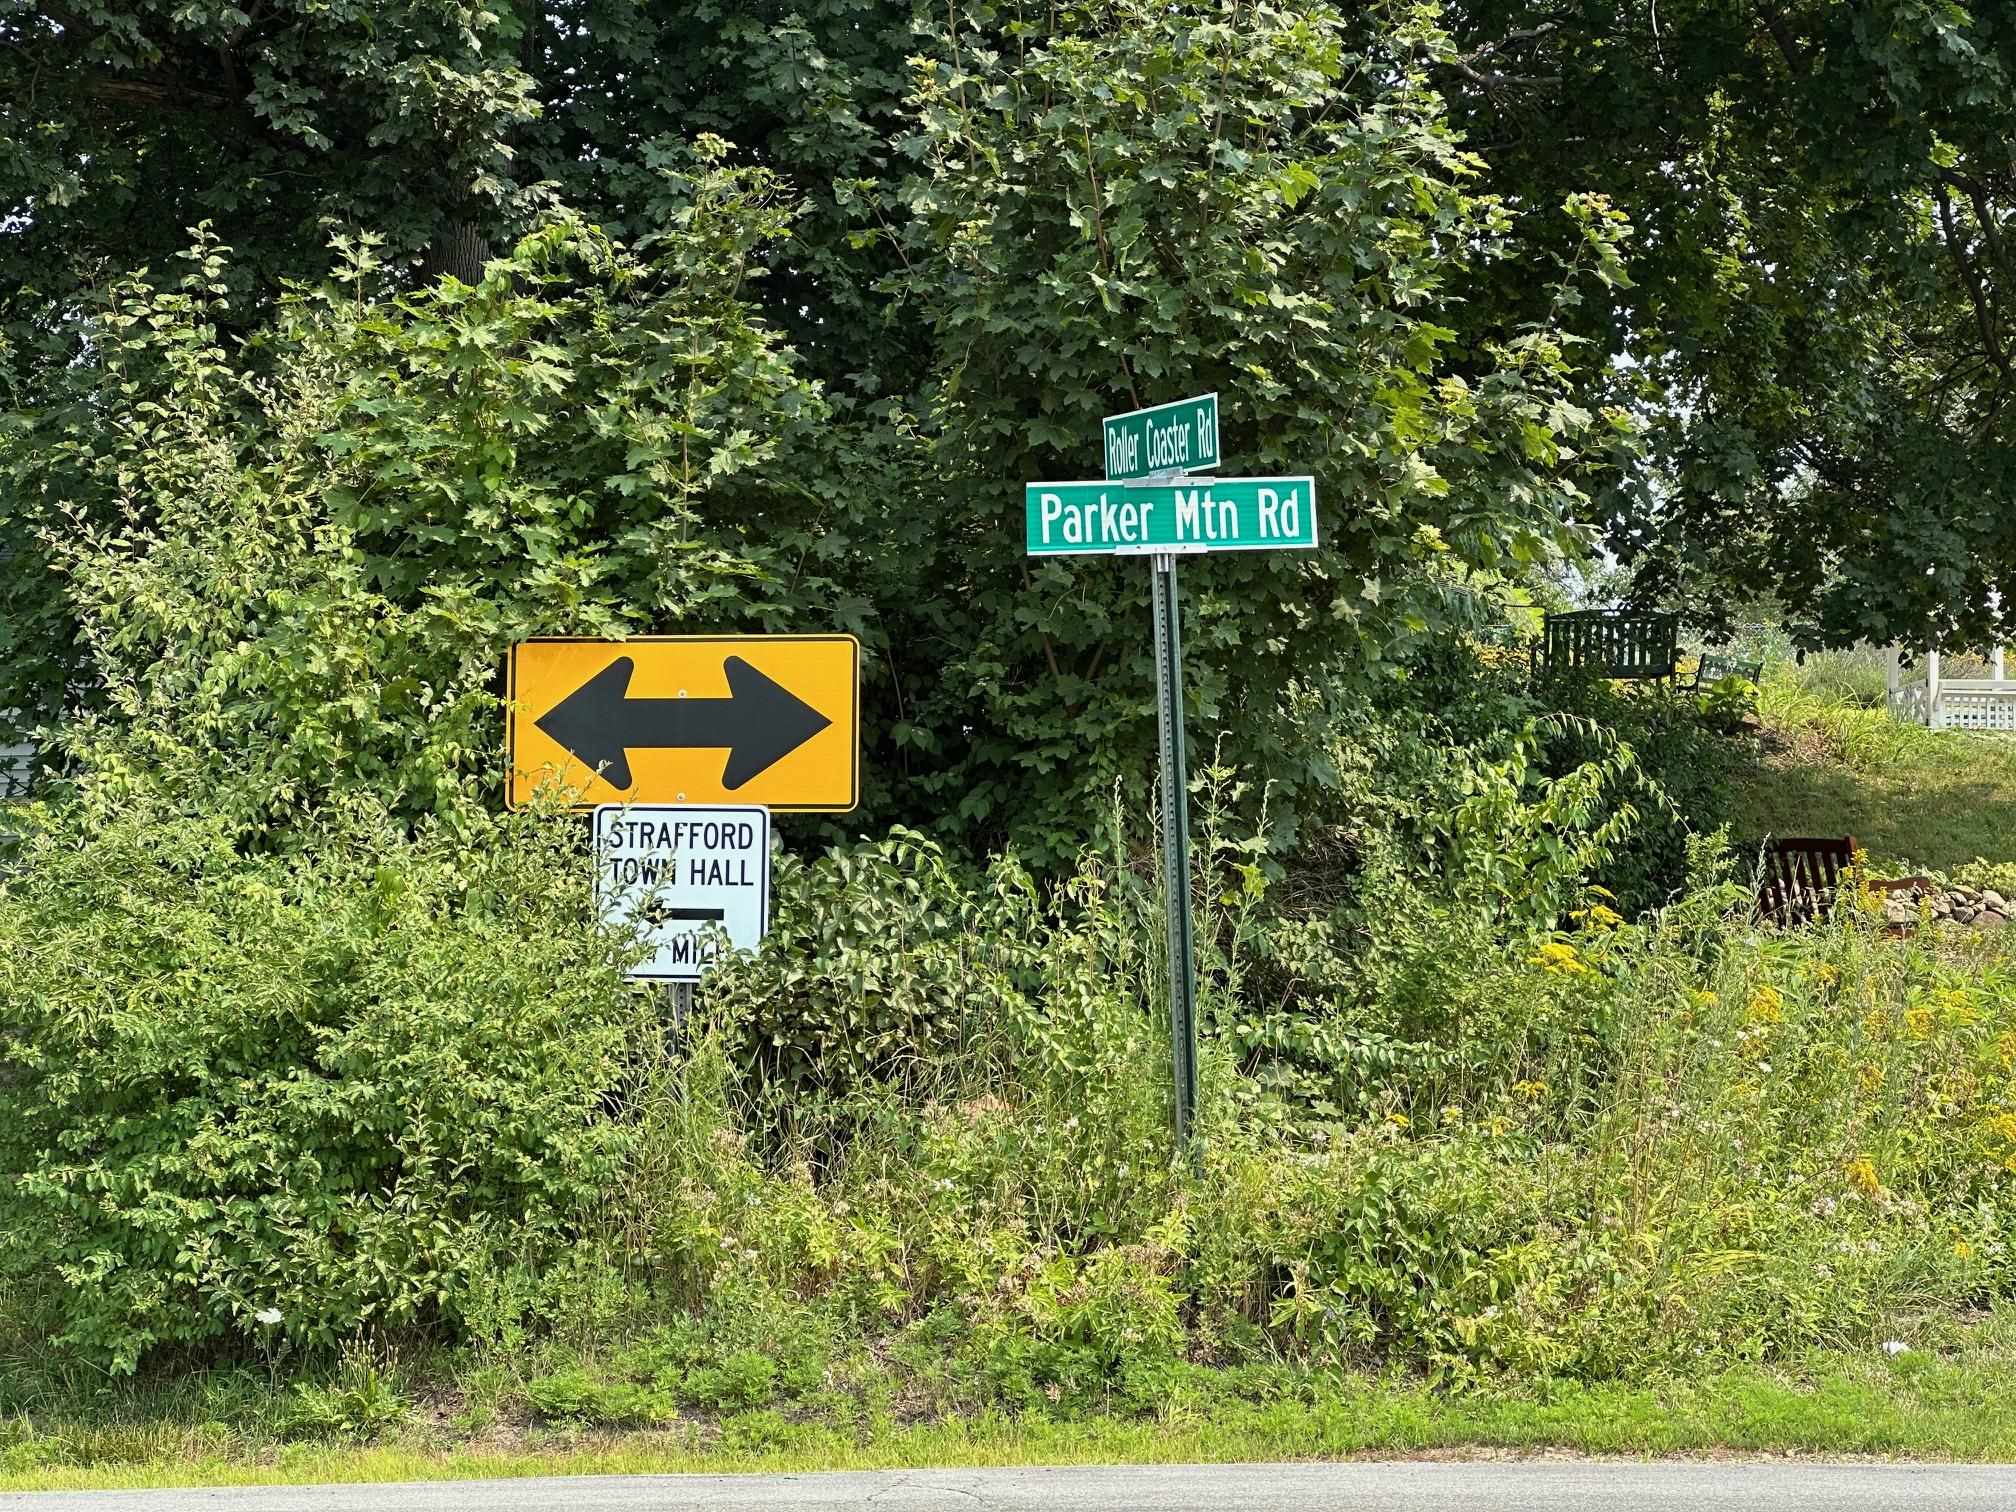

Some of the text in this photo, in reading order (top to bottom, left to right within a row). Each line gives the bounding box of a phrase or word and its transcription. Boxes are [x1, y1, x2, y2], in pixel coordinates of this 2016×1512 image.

[1109, 408, 1213, 476] Roller Coaster Rd
[1040, 487, 1300, 544] Parker Mtn Rd
[610, 822, 753, 849] STRAFFORD
[610, 858, 754, 886] TOWN HALL
